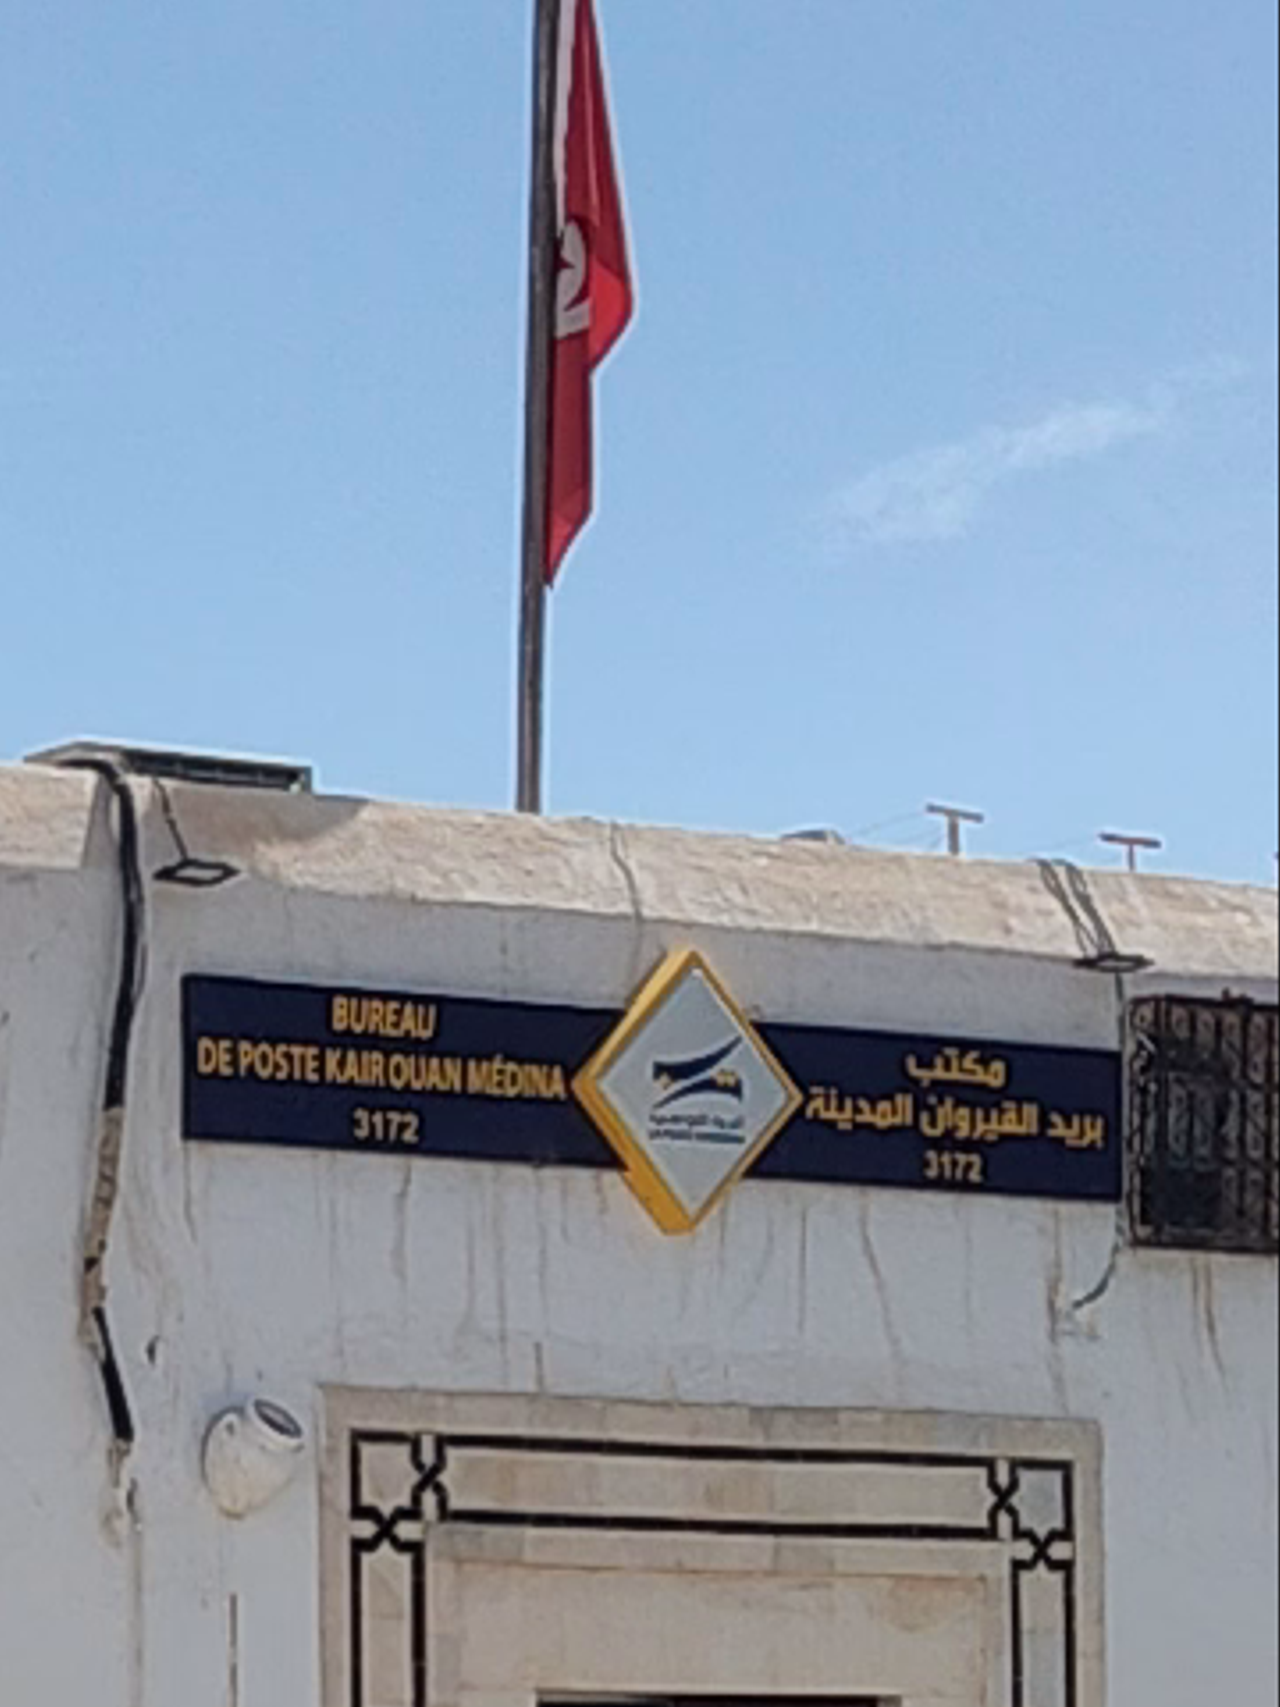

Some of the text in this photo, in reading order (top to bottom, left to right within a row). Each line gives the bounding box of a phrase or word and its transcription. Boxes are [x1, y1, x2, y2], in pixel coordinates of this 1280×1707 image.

[331, 995, 437, 1039] BUREAU
[196, 1036, 567, 1101] DE POSTE KAIROUAN MÉDINA
[904, 1046, 1007, 1088] مكتب
[352, 1106, 421, 1143] 3172
[804, 1085, 1105, 1149] بريد القيروان المدينة
[922, 1149, 983, 1184] 3172
